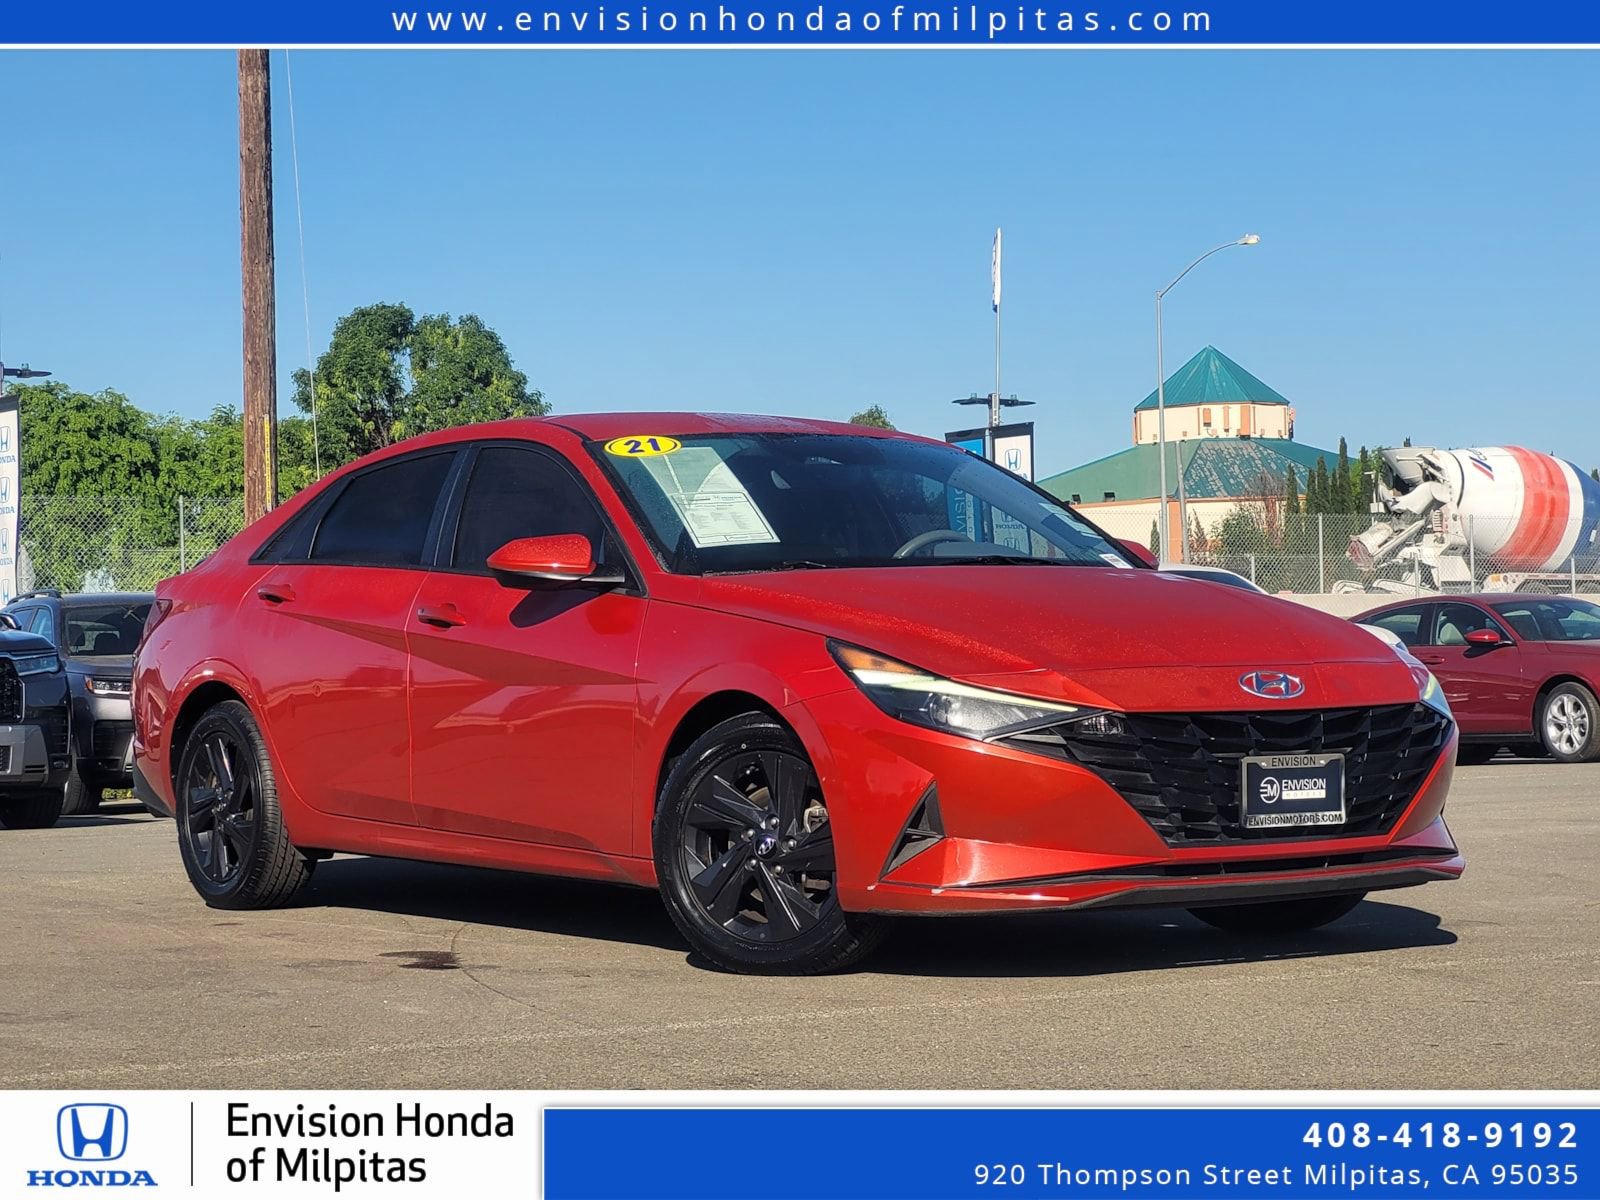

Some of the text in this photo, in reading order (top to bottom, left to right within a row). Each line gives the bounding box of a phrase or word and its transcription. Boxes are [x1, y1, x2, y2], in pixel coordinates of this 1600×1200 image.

[624, 438, 661, 453] 21
[1271, 756, 1316, 767] ENVISION
[1281, 778, 1326, 791] ENVISION
[1248, 813, 1343, 826] ENVISIONMOTORS.COM
